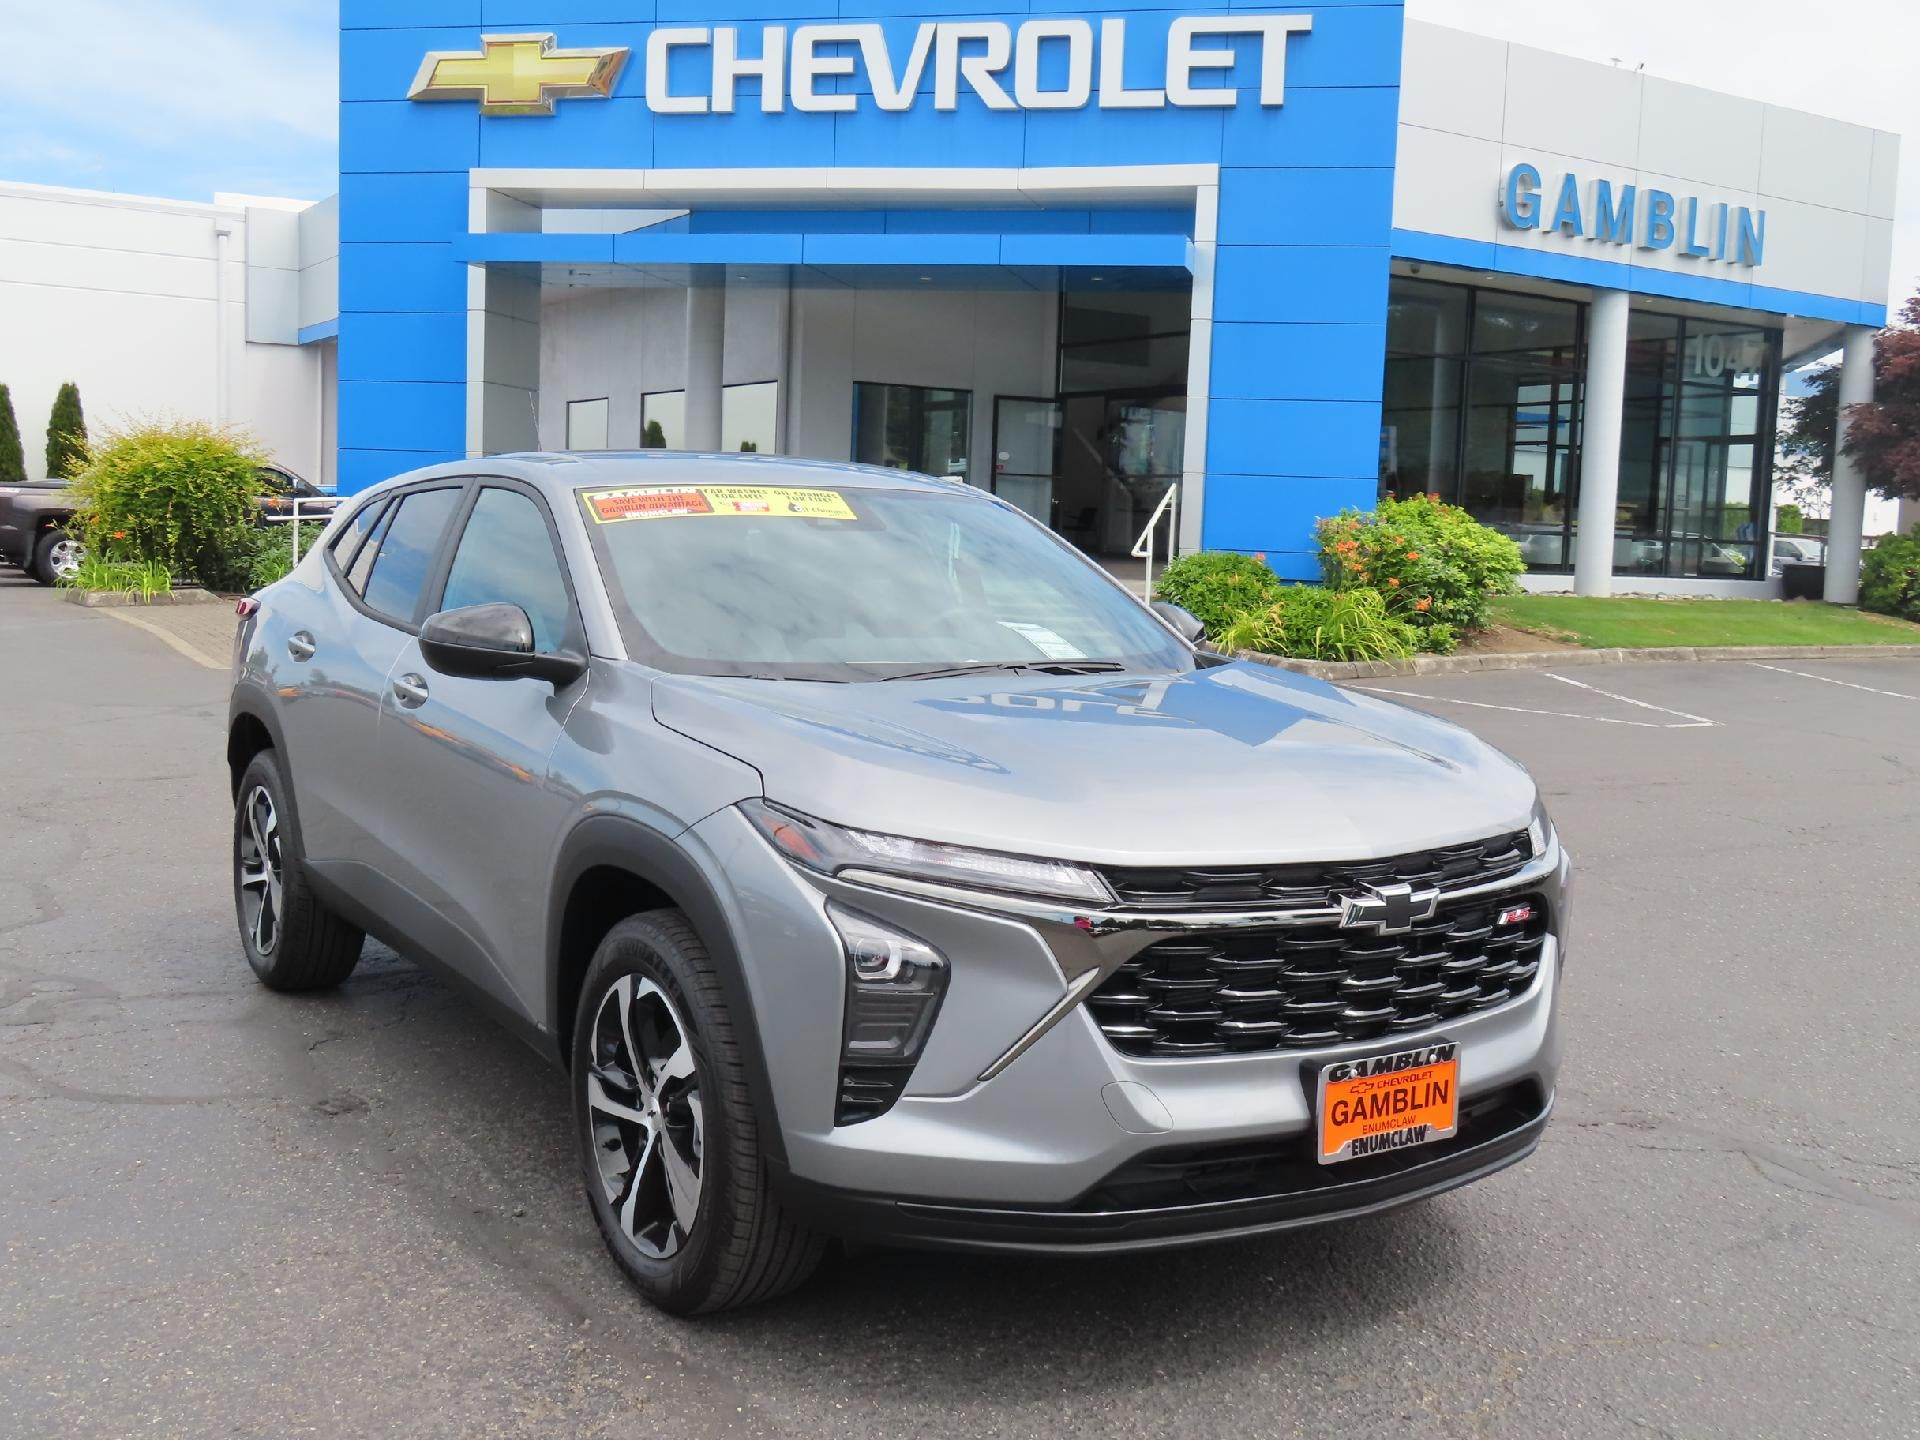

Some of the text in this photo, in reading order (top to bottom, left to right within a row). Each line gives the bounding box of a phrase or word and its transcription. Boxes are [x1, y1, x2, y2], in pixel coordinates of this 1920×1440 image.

[646, 14, 1313, 114] CHEVROLET
[1503, 162, 1766, 267] GAMBLIN
[601, 502, 646, 514] GAMBLIN
[649, 500, 705, 510] ADVANTAGE
[612, 496, 637, 505] SAVE
[639, 496, 665, 504] WITH
[1329, 1045, 1457, 1082] GAMBLIN
[1377, 1071, 1433, 1089] CHEVROLET
[1331, 1079, 1449, 1127] GAMBLIN
[1351, 1125, 1428, 1157] ENUMCLAW
[1362, 1115, 1417, 1135] ENUMCLAW
